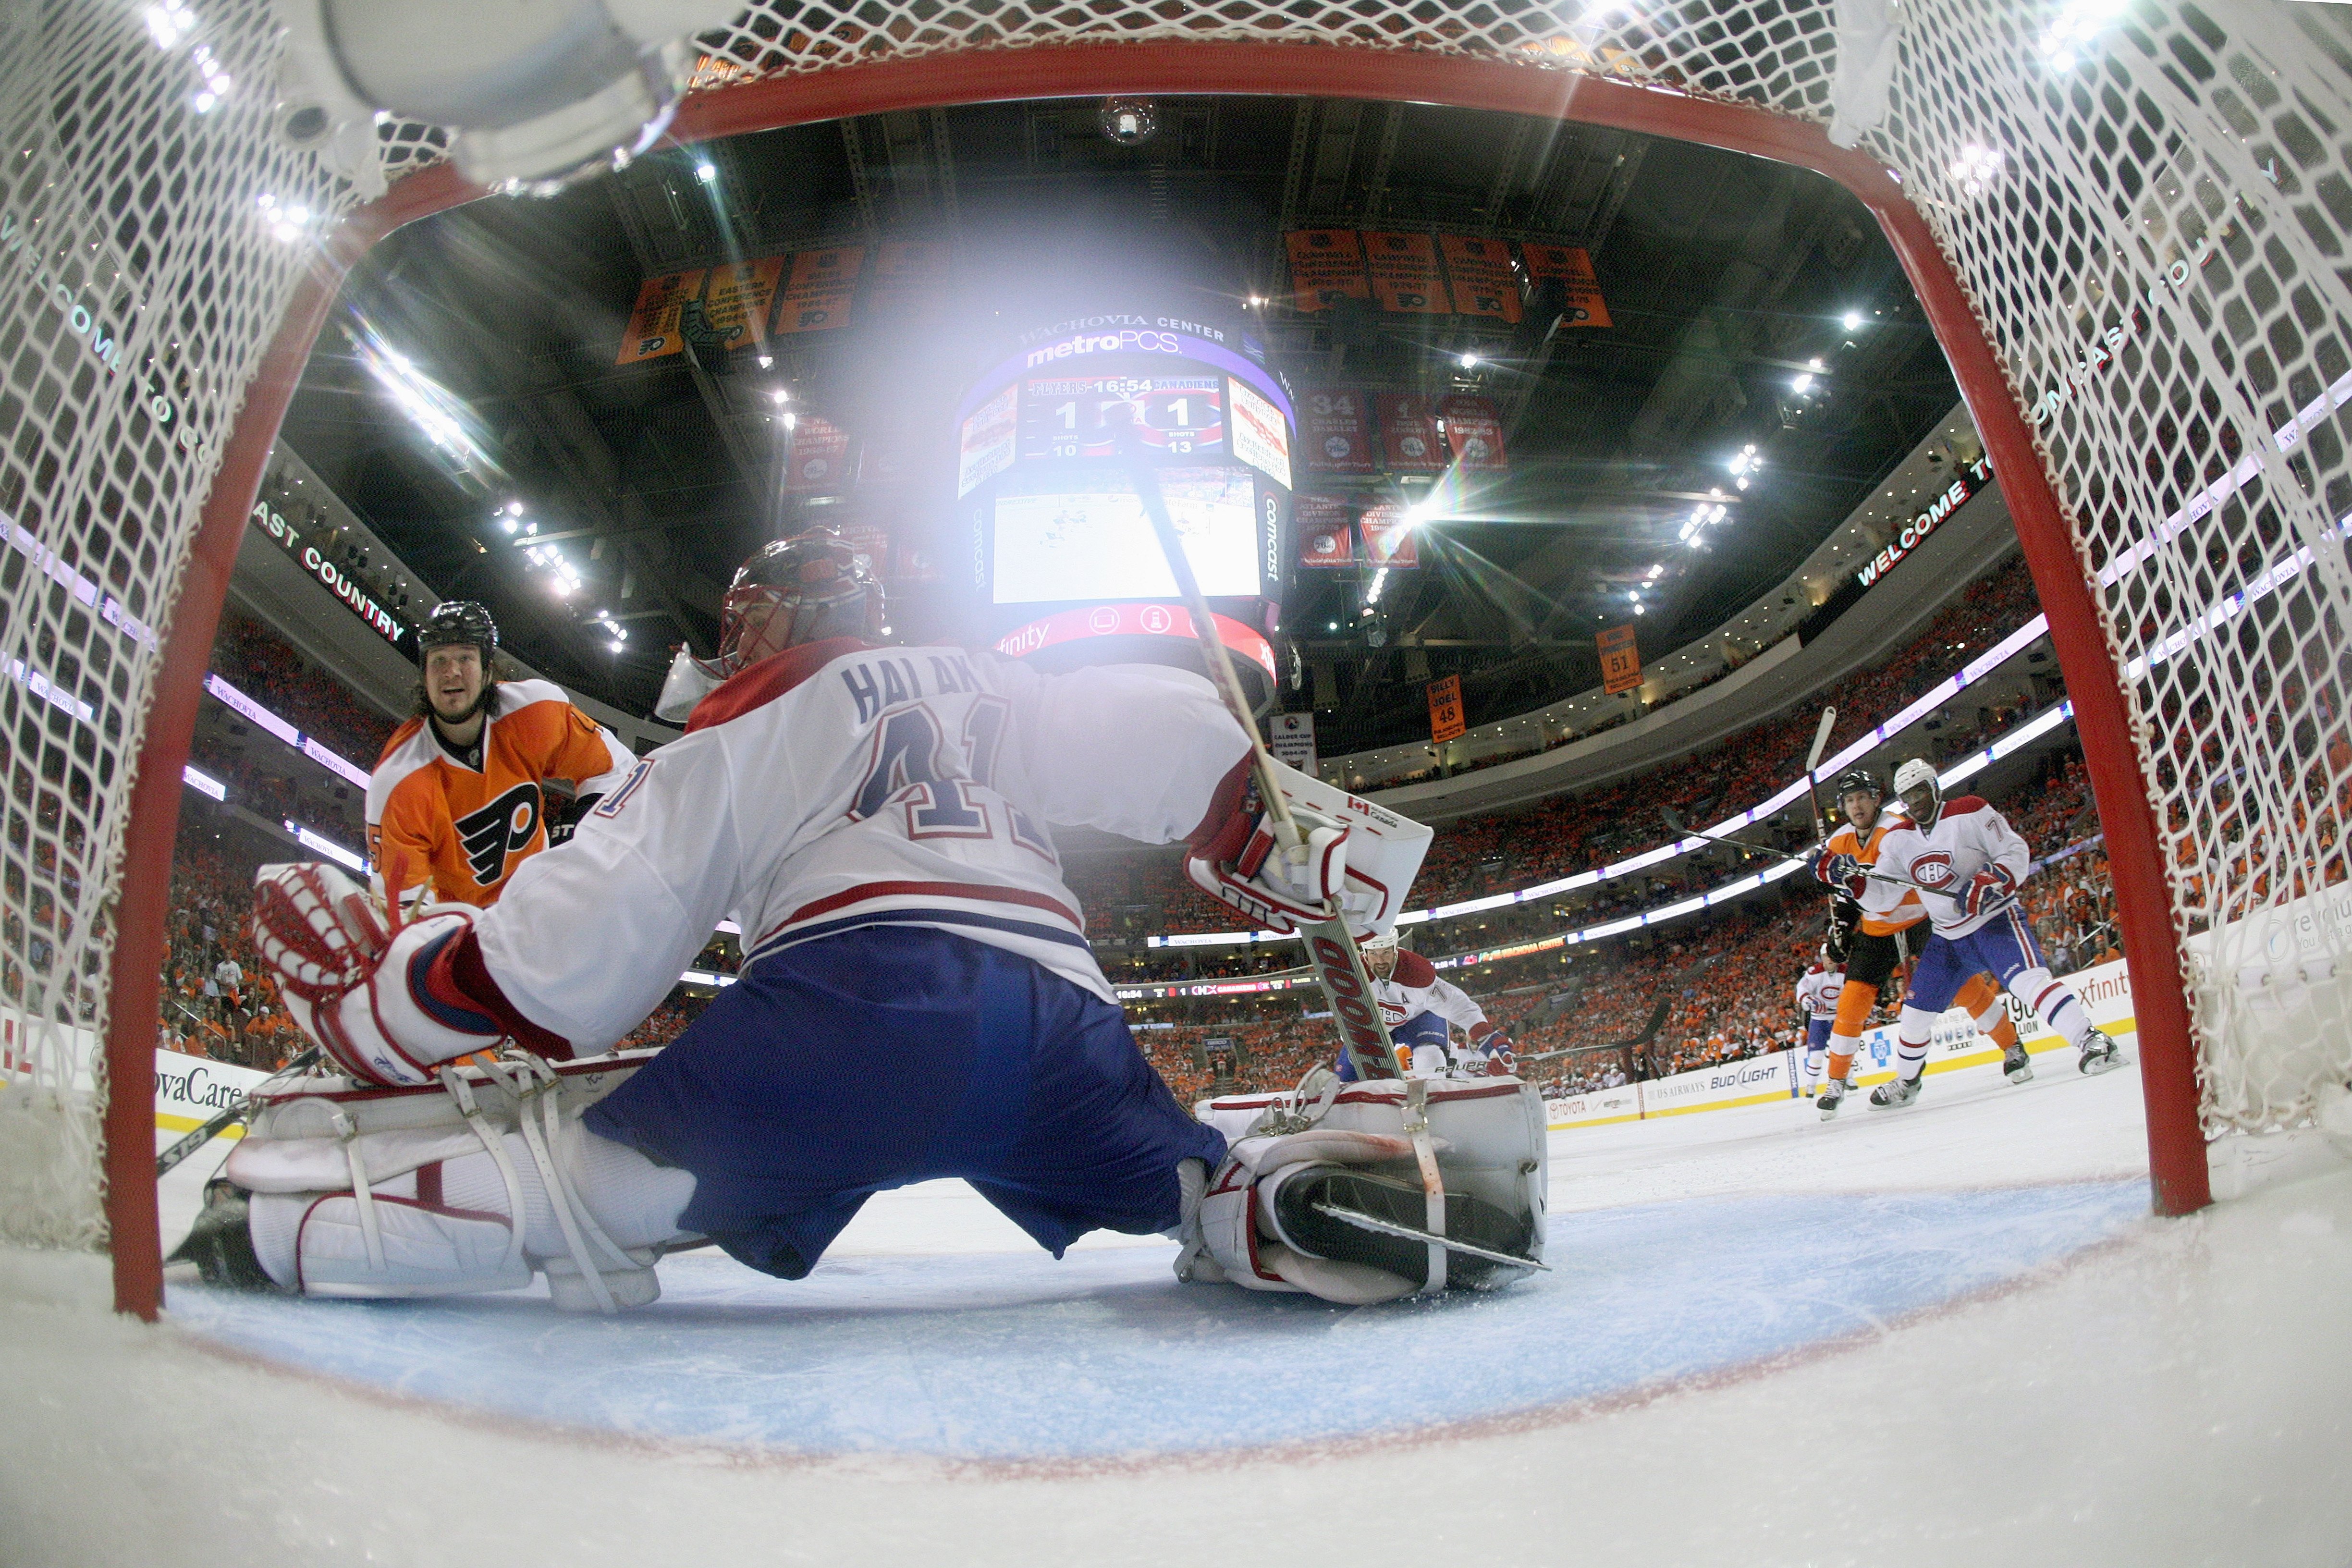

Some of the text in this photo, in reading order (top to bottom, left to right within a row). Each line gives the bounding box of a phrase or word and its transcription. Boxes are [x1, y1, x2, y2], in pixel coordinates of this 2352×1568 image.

[1019, 315, 1224, 345] WACHOVIA CENTER
[1093, 379, 1152, 393] 16:54
[1056, 398, 1188, 429] 1 1
[1311, 395, 1354, 416] 34
[1054, 441, 1192, 457] 10 13
[1266, 498, 1279, 582] comcast
[1857, 479, 1970, 587] WELCOME
[972, 507, 986, 592] comcast
[300, 546, 404, 642] COUNTRY
[1611, 655, 1629, 673] 51
[1970, 649, 2009, 678] WACHOVIA
[1431, 679, 1455, 694] BILLY
[217, 686, 257, 720] WACHOVIA
[1433, 693, 1457, 707] JOEL
[1439, 707, 1456, 723] 48
[311, 747, 346, 775] WACHOVIA
[1370, 811, 1398, 828] Canada
[304, 835, 333, 857] WACHOVIA
[1264, 931, 1302, 940] WACHOVIA
[1116, 990, 1143, 999] 16:54
[1180, 988, 1186, 996] 1
[1711, 1066, 1778, 1090] BUD LIGHT
[1657, 1088, 1667, 1099] US
[1668, 1081, 1705, 1099] AIRWAYS
[1558, 1101, 1587, 1115] TOYOTA
